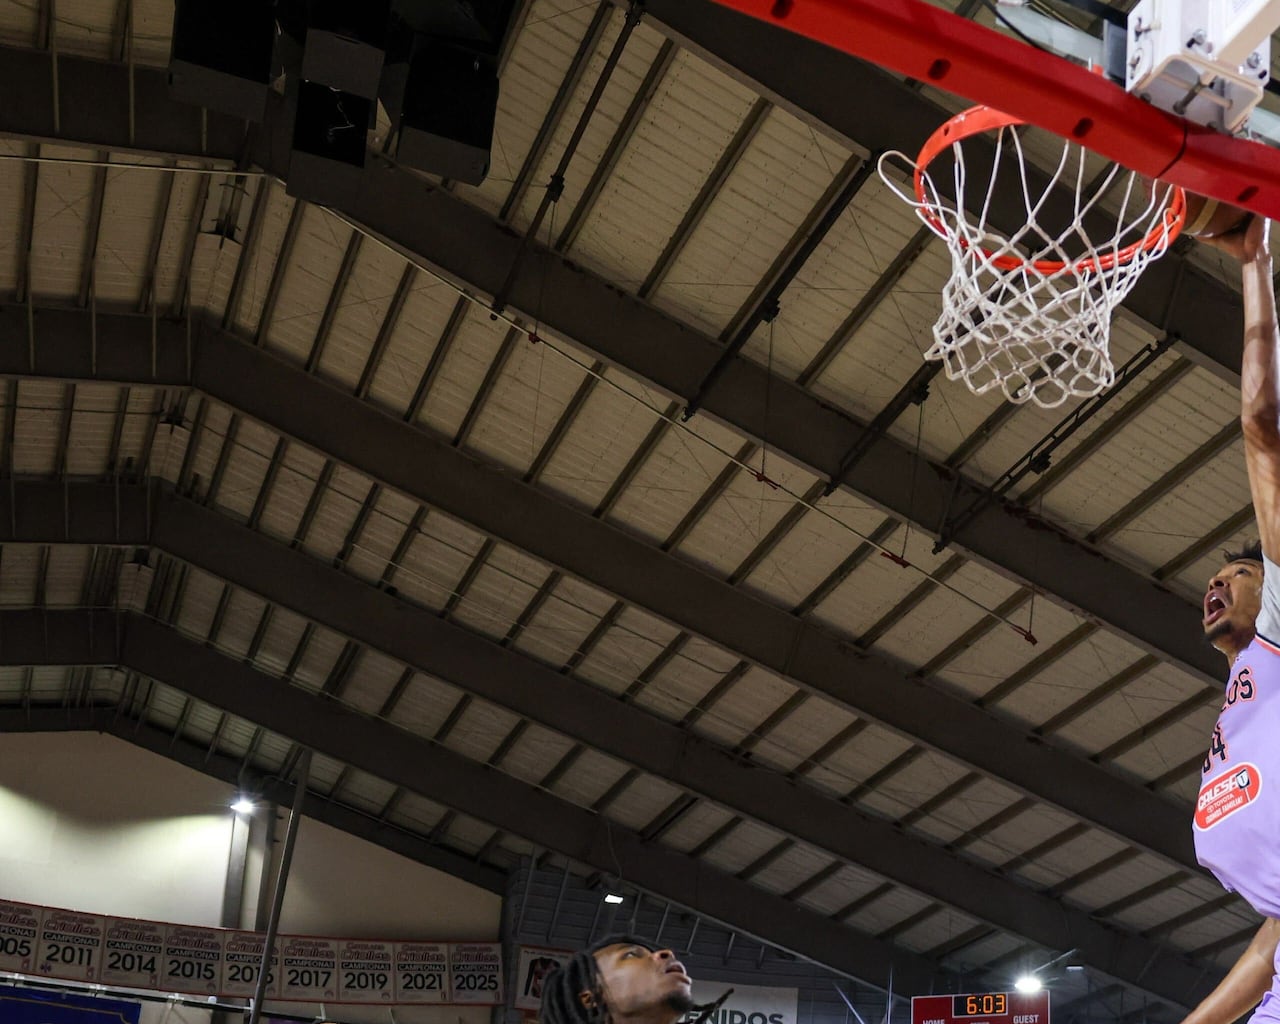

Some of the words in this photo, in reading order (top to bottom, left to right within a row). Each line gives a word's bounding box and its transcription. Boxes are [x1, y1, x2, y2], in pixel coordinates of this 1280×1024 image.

[44, 932, 99, 947] CAMPEONAS
[108, 941, 161, 954] CAMPEONAS
[46, 944, 92, 966] 2011
[108, 951, 156, 973] 2014
[168, 949, 219, 960] CAMPEONAS
[168, 960, 215, 980] 2015
[286, 959, 335, 968] CAMPEONAS
[288, 970, 331, 987] 2017
[345, 972, 388, 989] 2019
[402, 973, 442, 990] 2021
[455, 974, 498, 991] 2025
[967, 995, 1005, 1014] 6:03
[1013, 1015, 1039, 1024] GUEST
